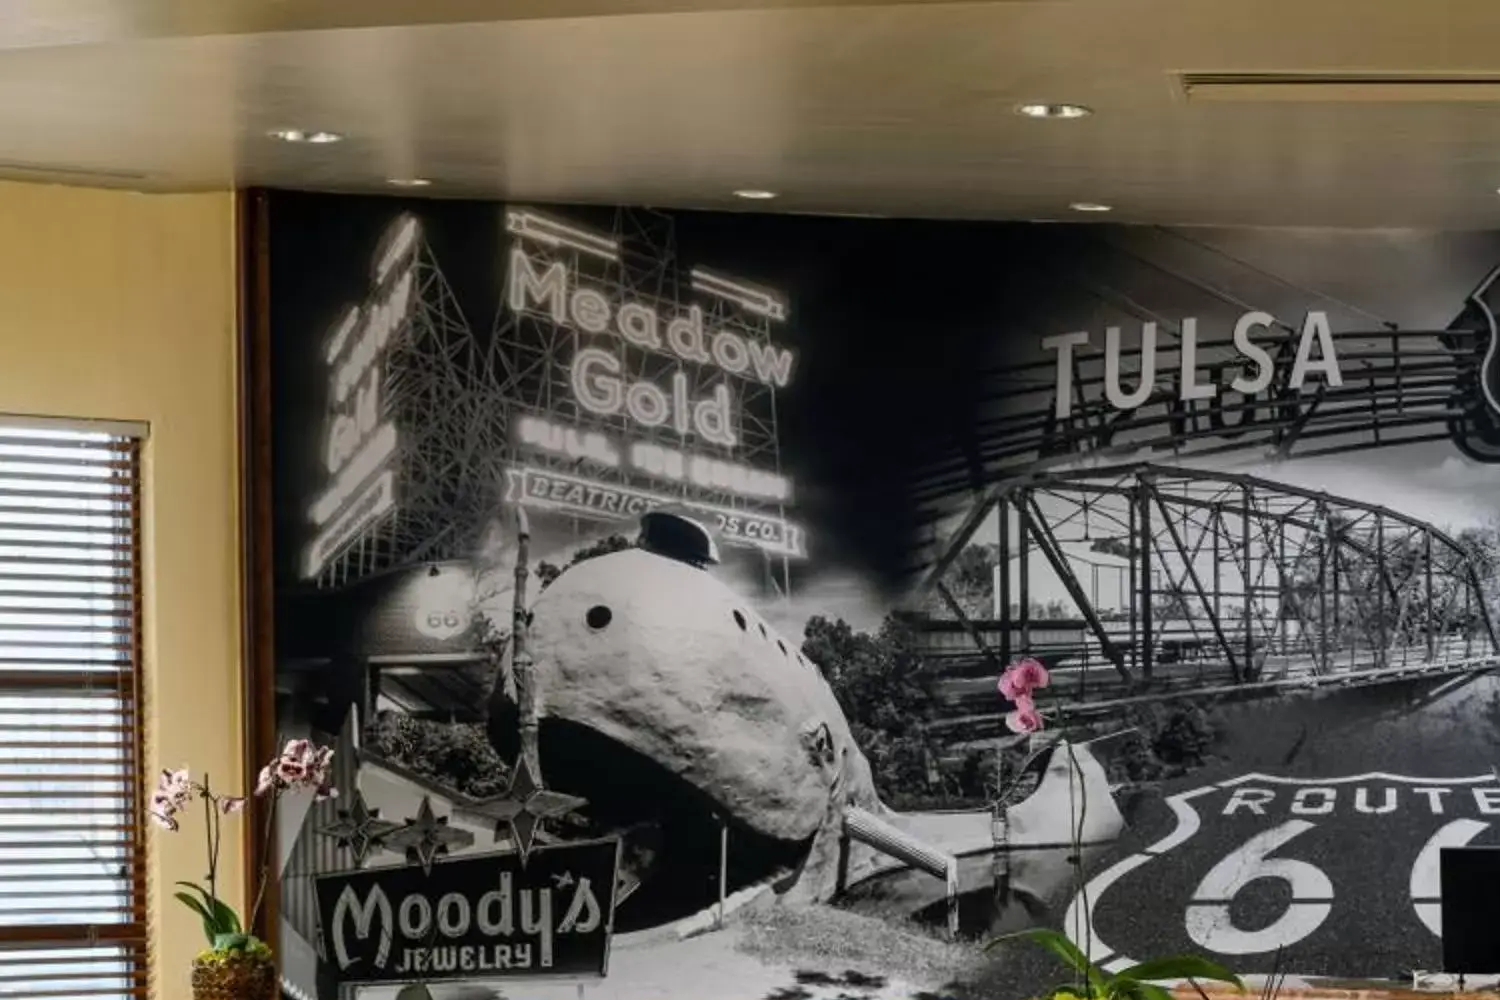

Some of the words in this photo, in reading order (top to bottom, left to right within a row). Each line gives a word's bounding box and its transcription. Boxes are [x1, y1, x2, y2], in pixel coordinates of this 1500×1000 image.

[510, 249, 794, 387] Meadow
[1041, 310, 1345, 419] TULSA
[571, 350, 738, 447] Gold
[331, 870, 602, 972] Moody's
[395, 942, 532, 974] JEWELRY
